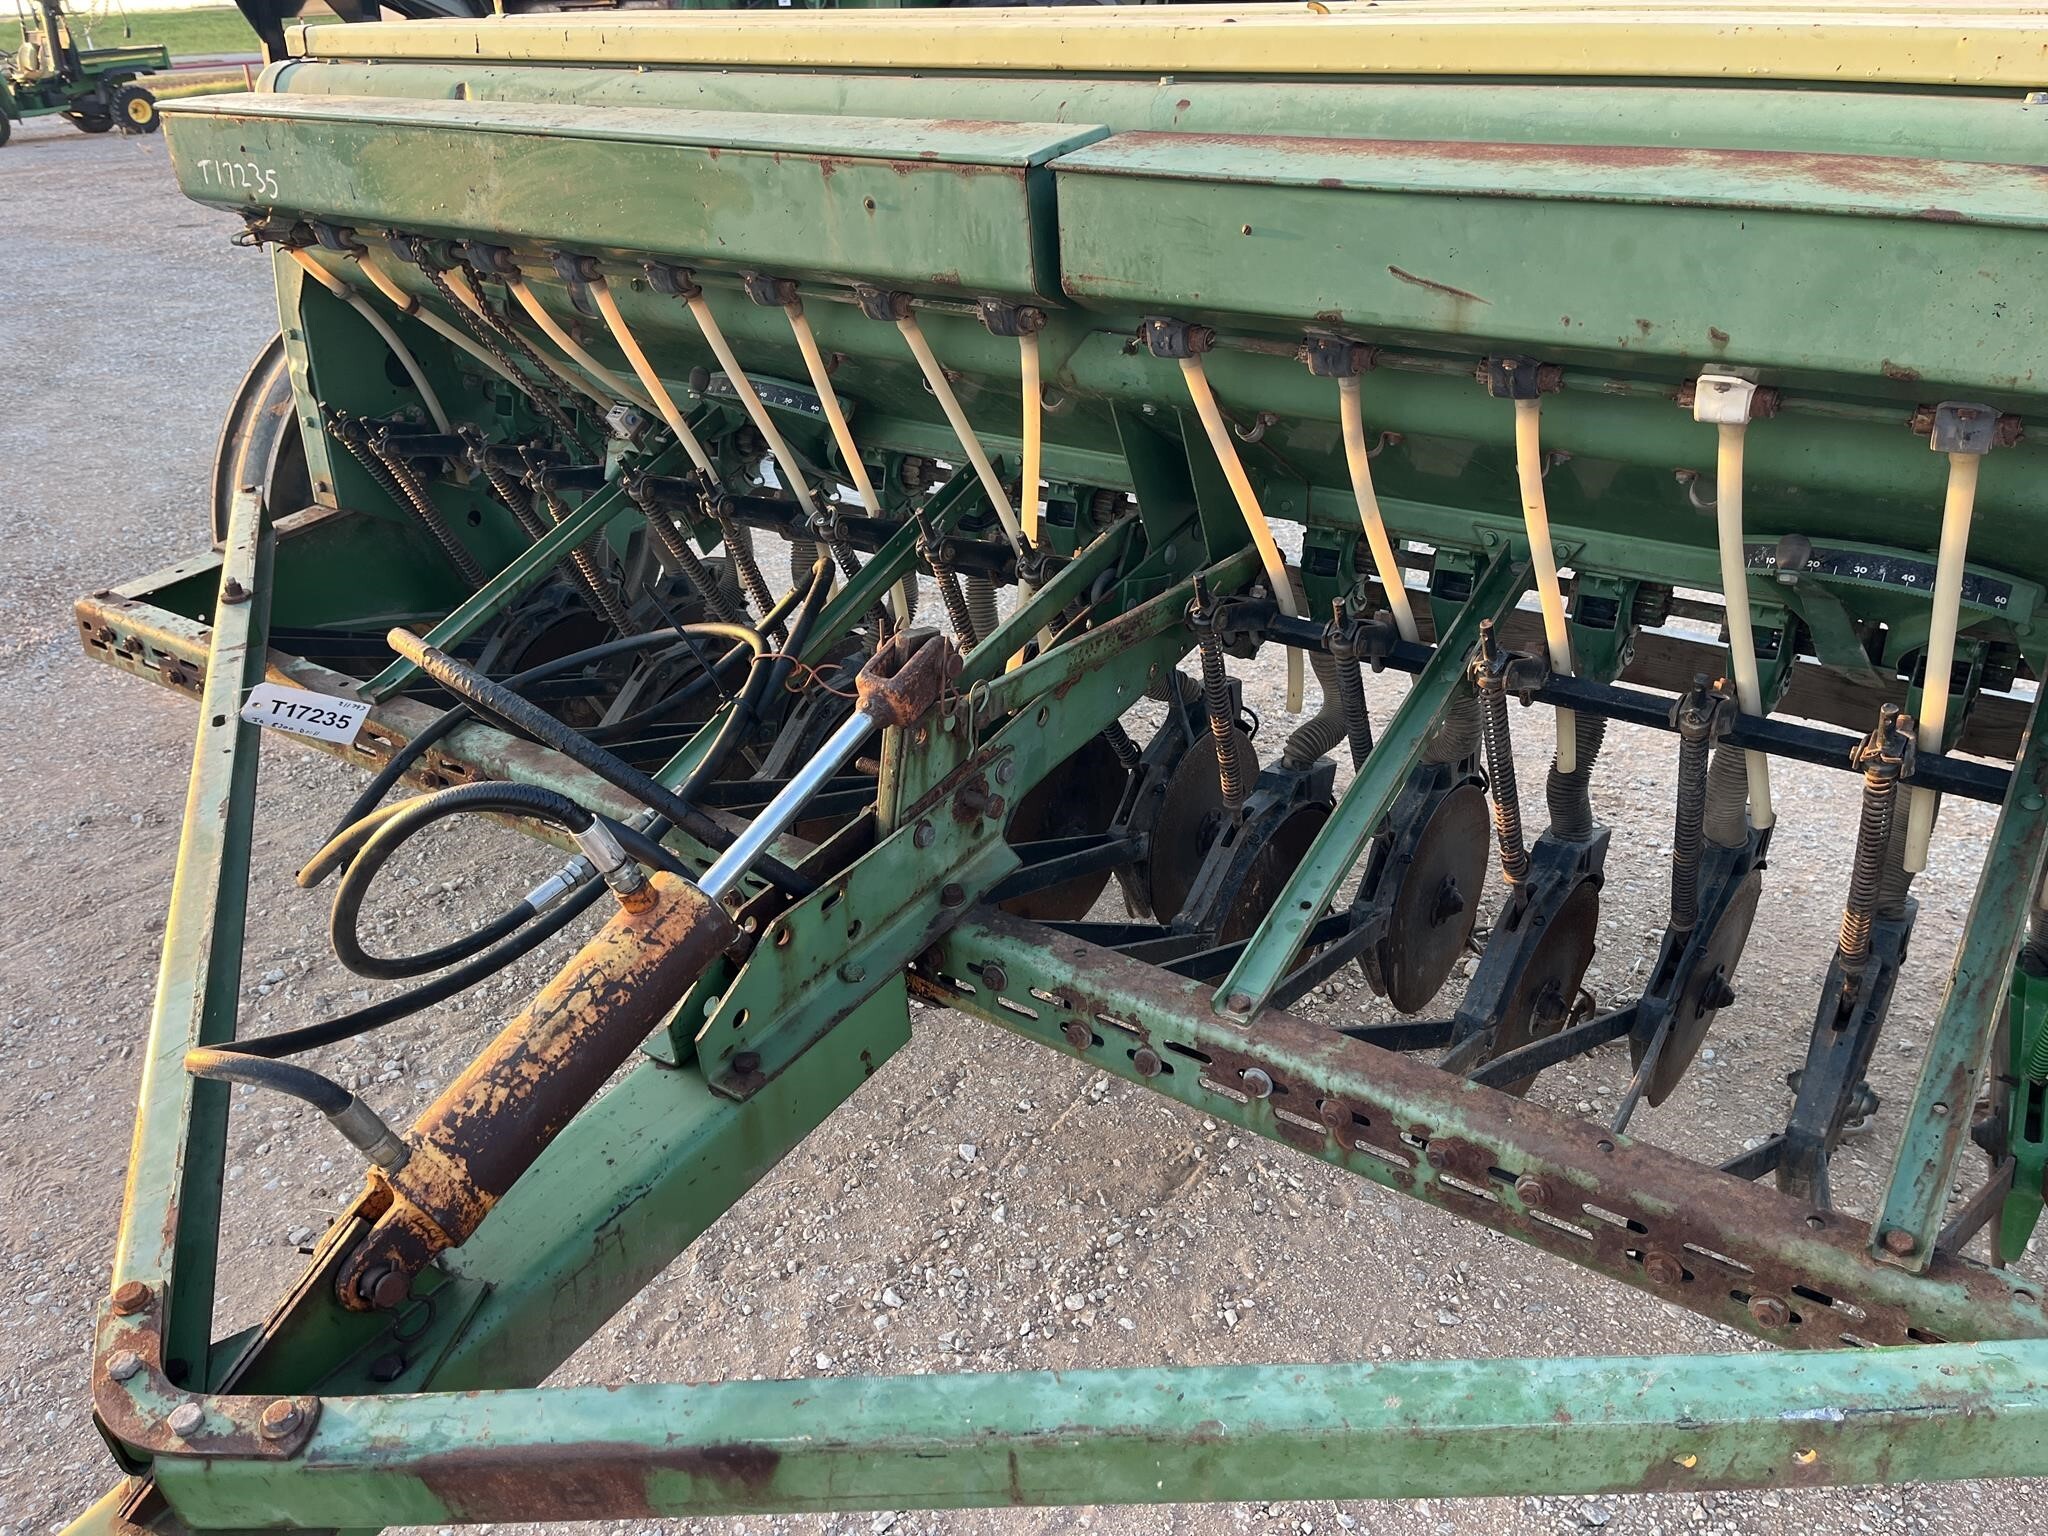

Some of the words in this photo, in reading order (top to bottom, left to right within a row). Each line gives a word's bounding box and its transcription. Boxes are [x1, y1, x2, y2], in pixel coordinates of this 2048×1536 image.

[197, 160, 279, 199] T17235
[1807, 560, 1821, 568] 20
[1853, 566, 1868, 574] 30
[1901, 574, 1916, 582] 40
[1994, 596, 2007, 605] 60
[271, 699, 352, 729] T17235
